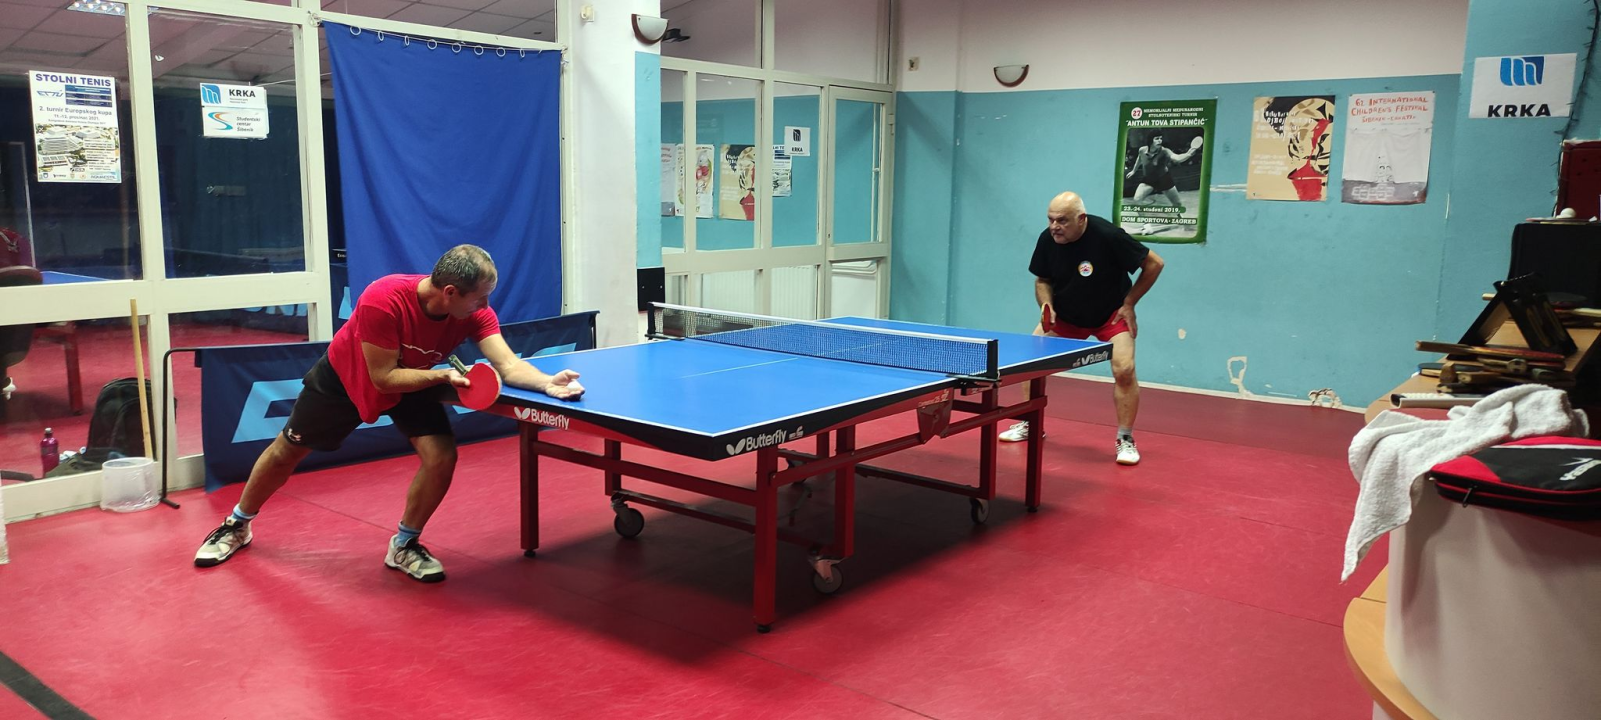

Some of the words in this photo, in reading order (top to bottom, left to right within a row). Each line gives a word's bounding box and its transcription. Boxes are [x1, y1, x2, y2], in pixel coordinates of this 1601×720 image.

[35, 73, 77, 84] STOLNI
[80, 77, 111, 87] TENIS
[229, 89, 256, 97] KRKA
[1487, 104, 1551, 118] KRKA
[531, 408, 570, 430] Butterfly
[745, 429, 787, 451] Butterfly
